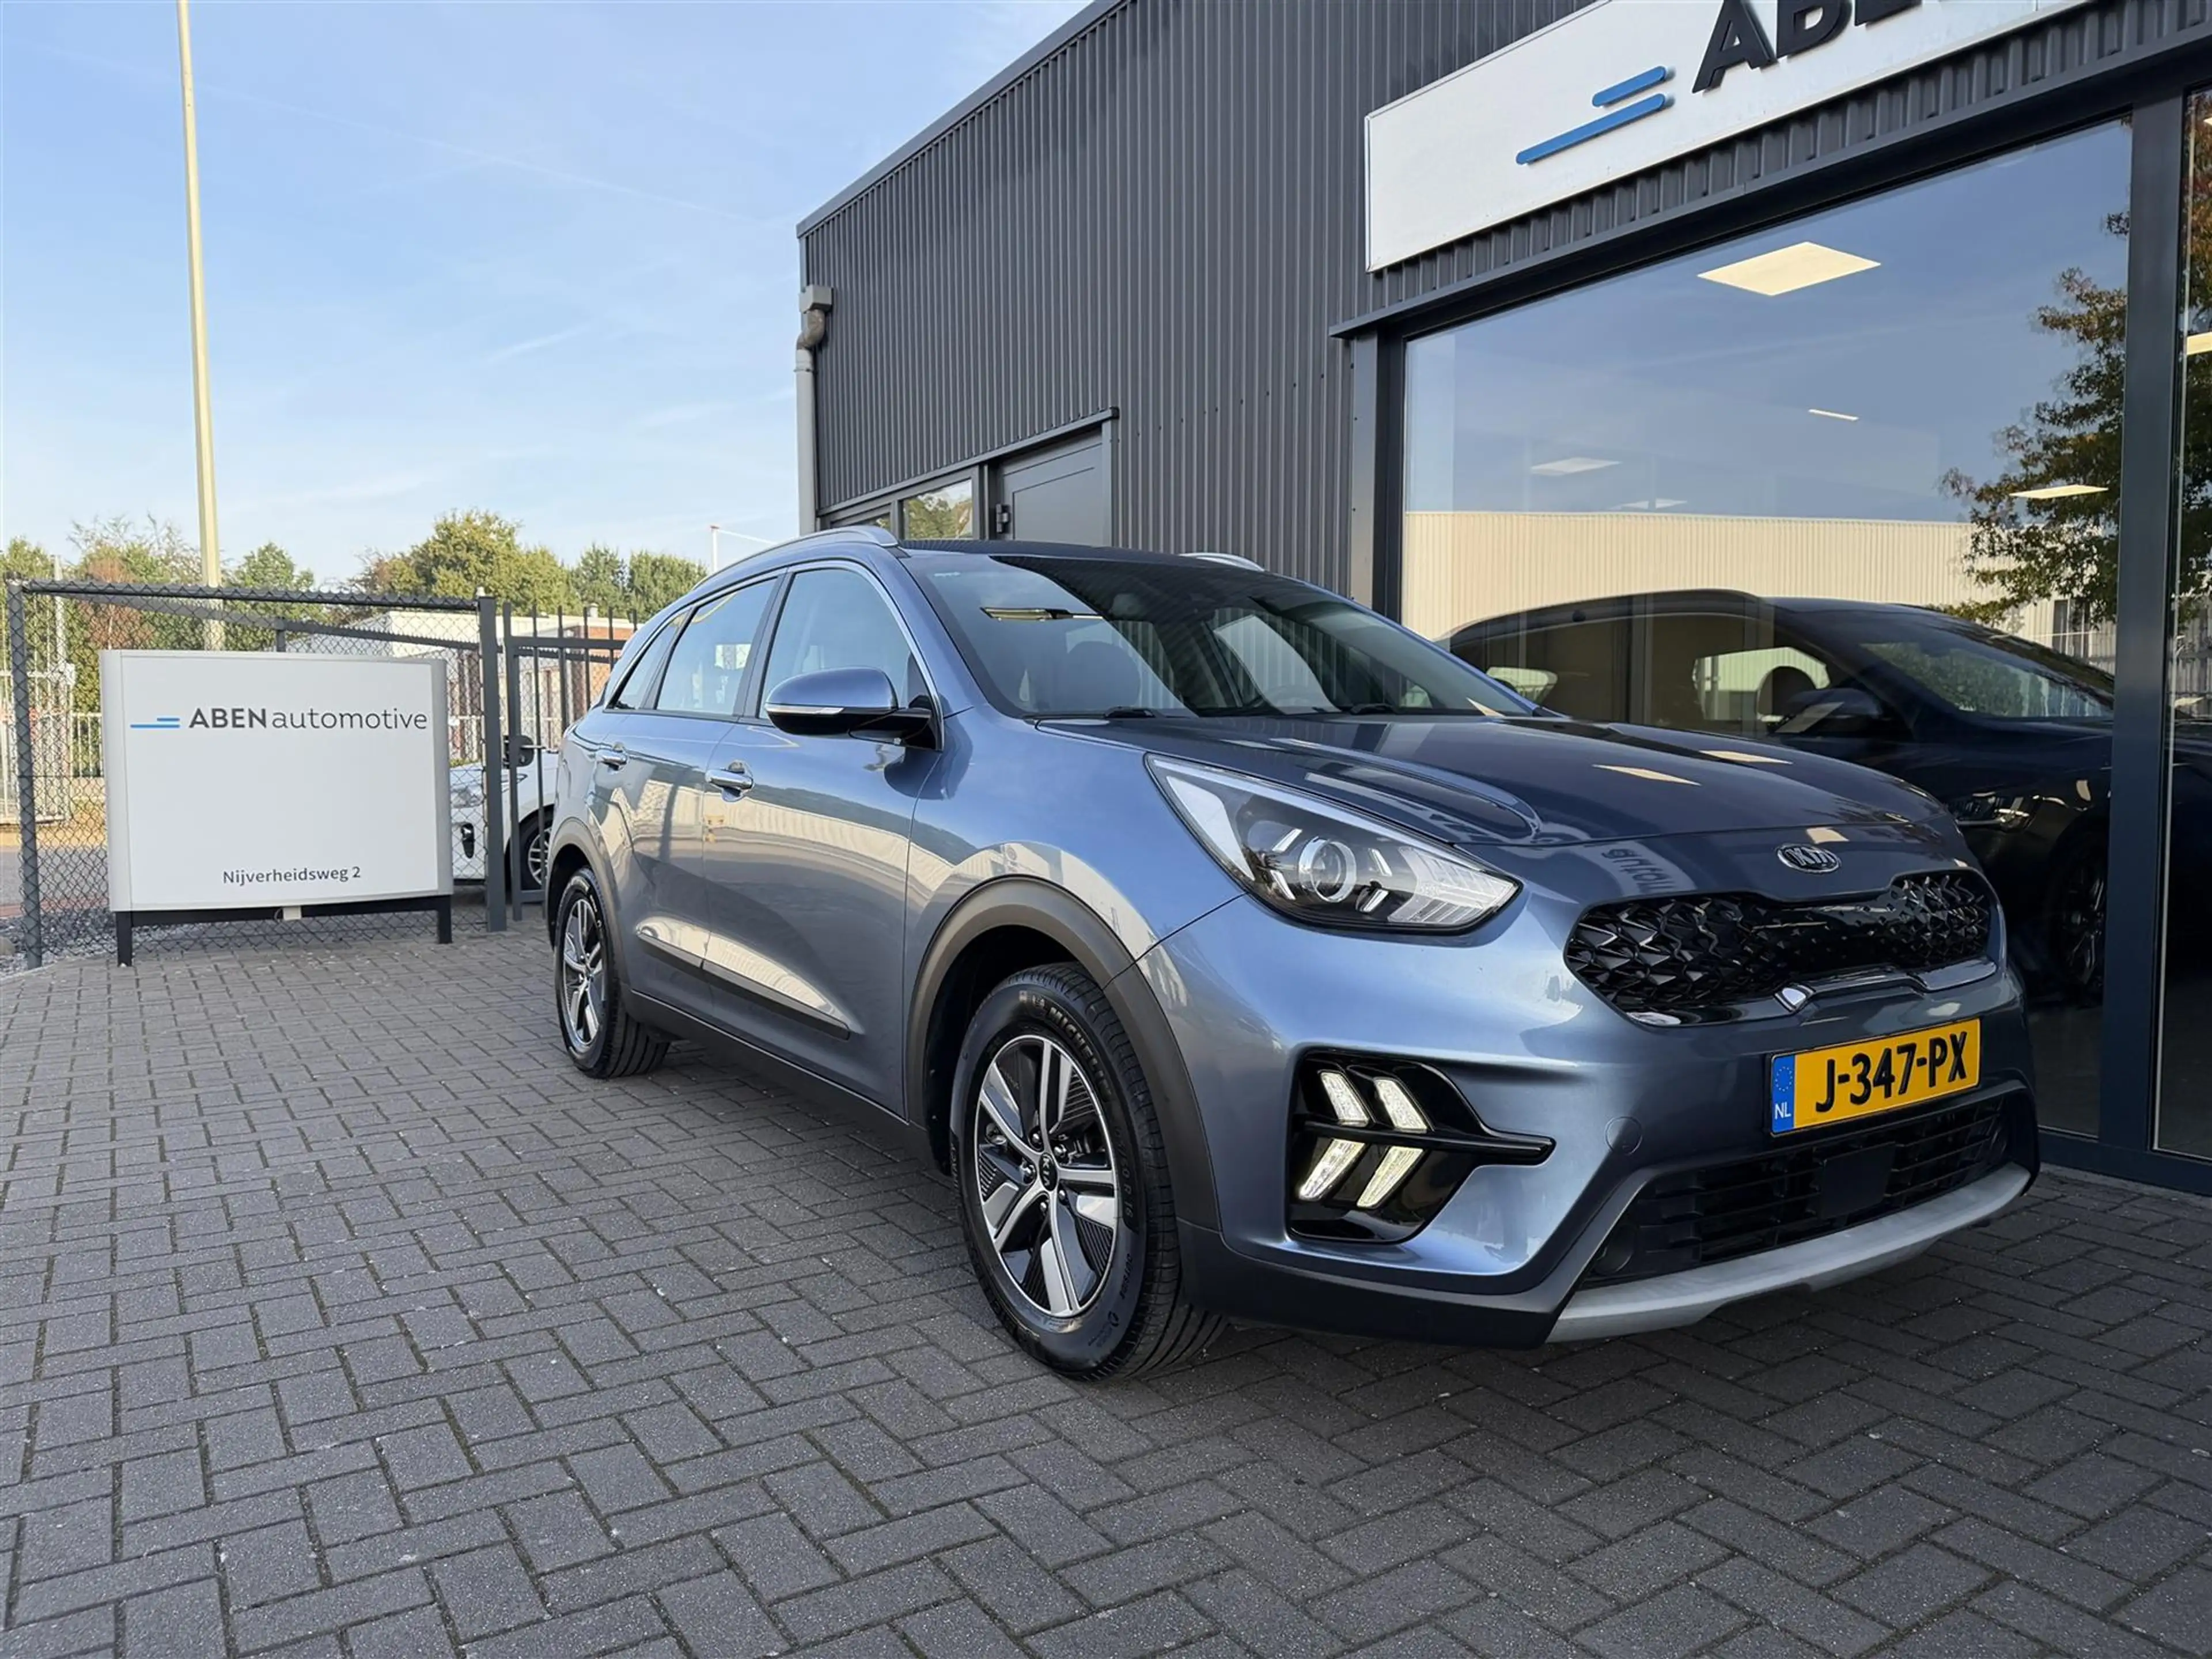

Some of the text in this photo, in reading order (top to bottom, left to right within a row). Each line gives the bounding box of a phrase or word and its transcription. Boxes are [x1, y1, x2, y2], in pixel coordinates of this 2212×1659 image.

[1785, 847, 1836, 866] KIA
[224, 866, 361, 886] Nijverheidsweg 2
[1048, 1007, 1113, 1098] MICHELIN
[1816, 1031, 1968, 1113] J-347-PX
[1775, 1103, 1791, 1119] NL
[1040, 1156, 1050, 1187] KIA
